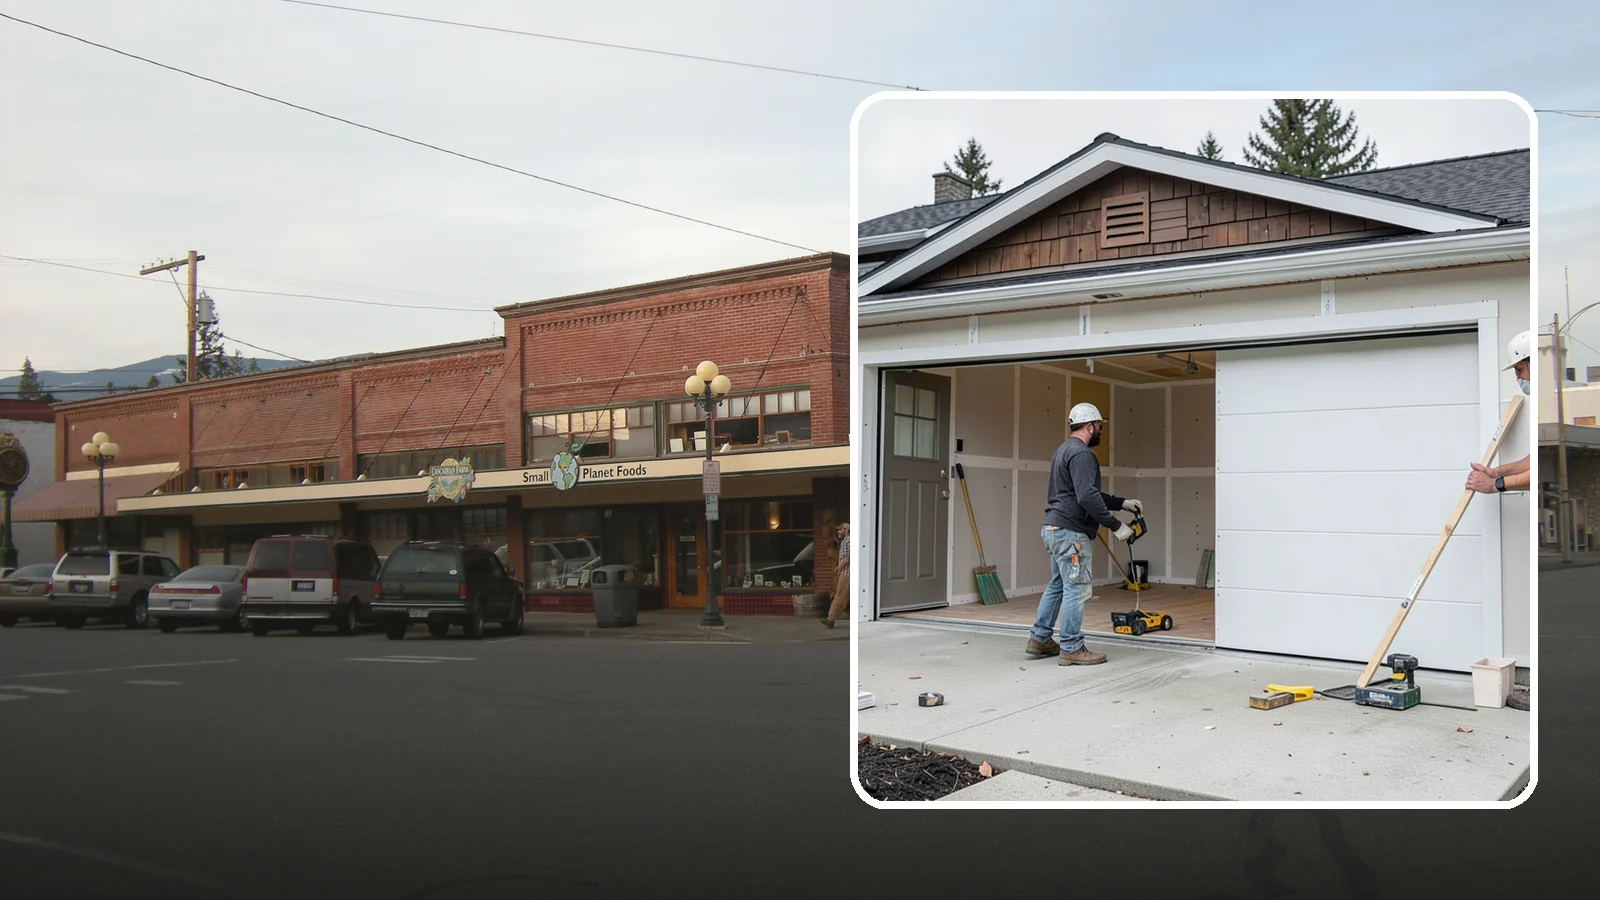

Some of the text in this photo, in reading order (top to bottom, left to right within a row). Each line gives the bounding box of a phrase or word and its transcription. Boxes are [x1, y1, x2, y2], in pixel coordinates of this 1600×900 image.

[523, 464, 647, 482] Small Planet Foods
